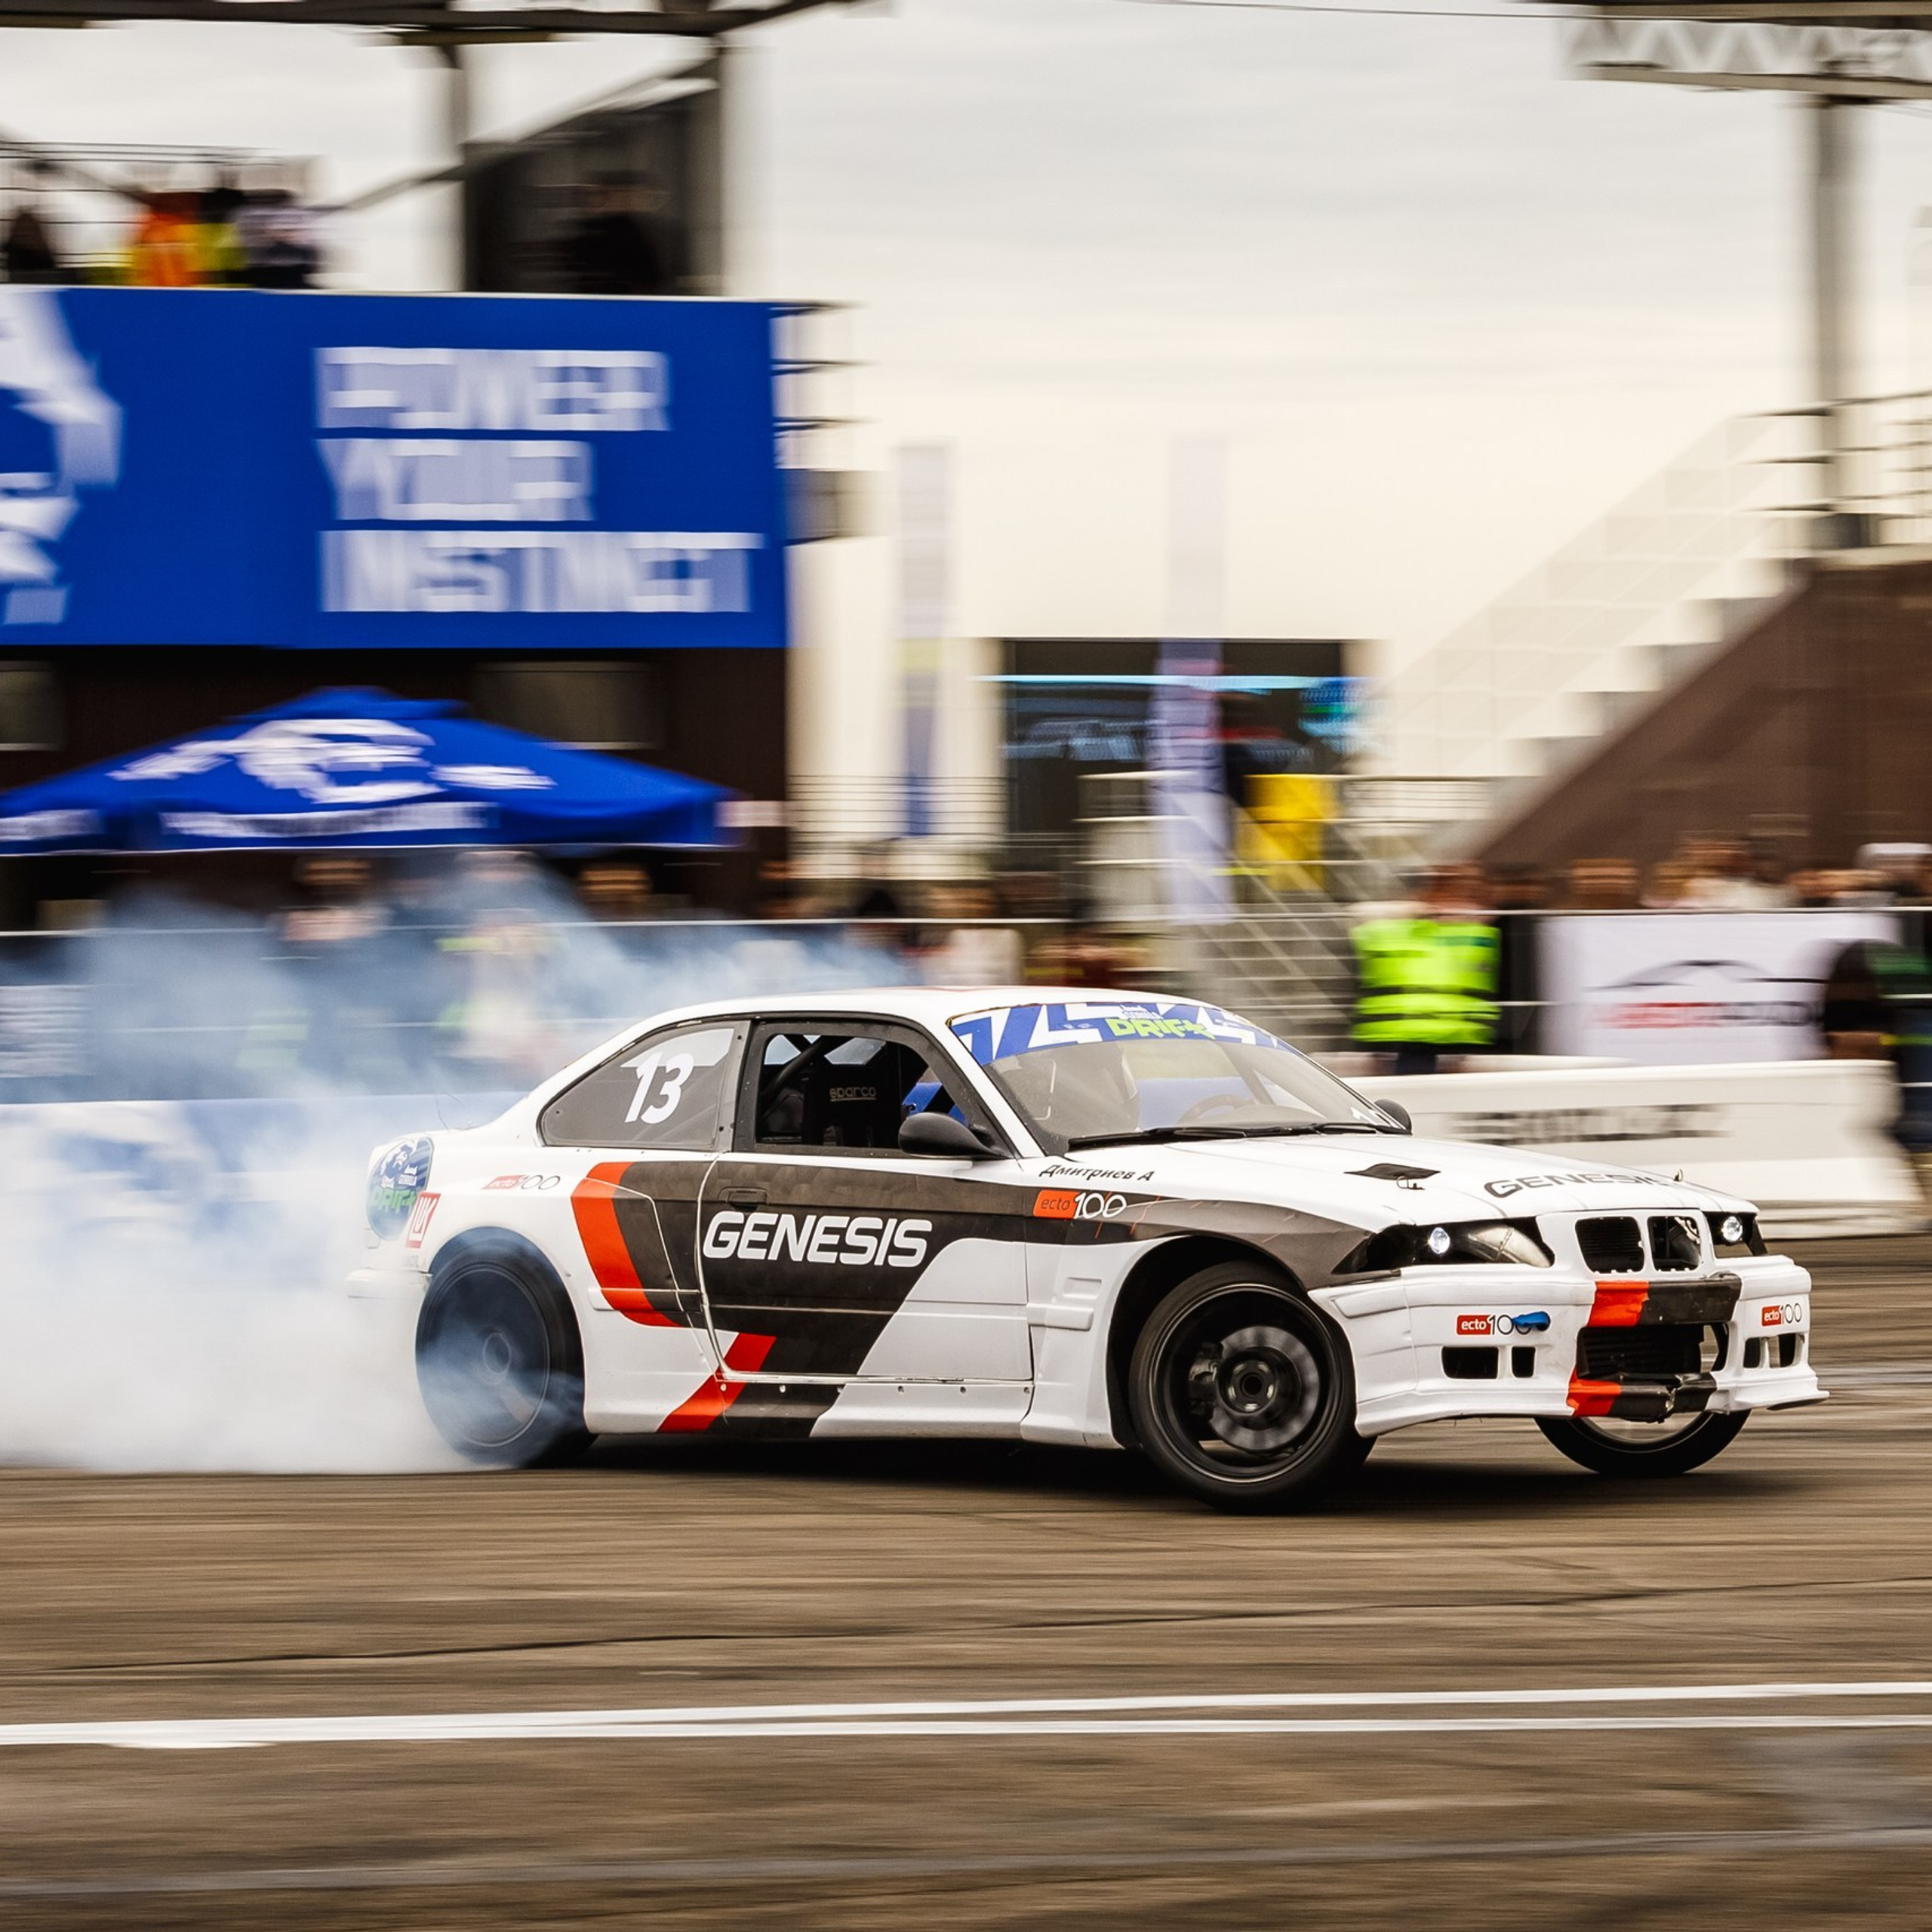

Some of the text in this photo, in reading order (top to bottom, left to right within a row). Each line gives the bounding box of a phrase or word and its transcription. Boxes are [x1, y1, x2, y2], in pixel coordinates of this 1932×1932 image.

[624, 1051, 694, 1124] 13
[830, 1087, 876, 1099] sparco
[1038, 1164, 1134, 1180] Дмитриев
[703, 1211, 933, 1267] GENESIS
